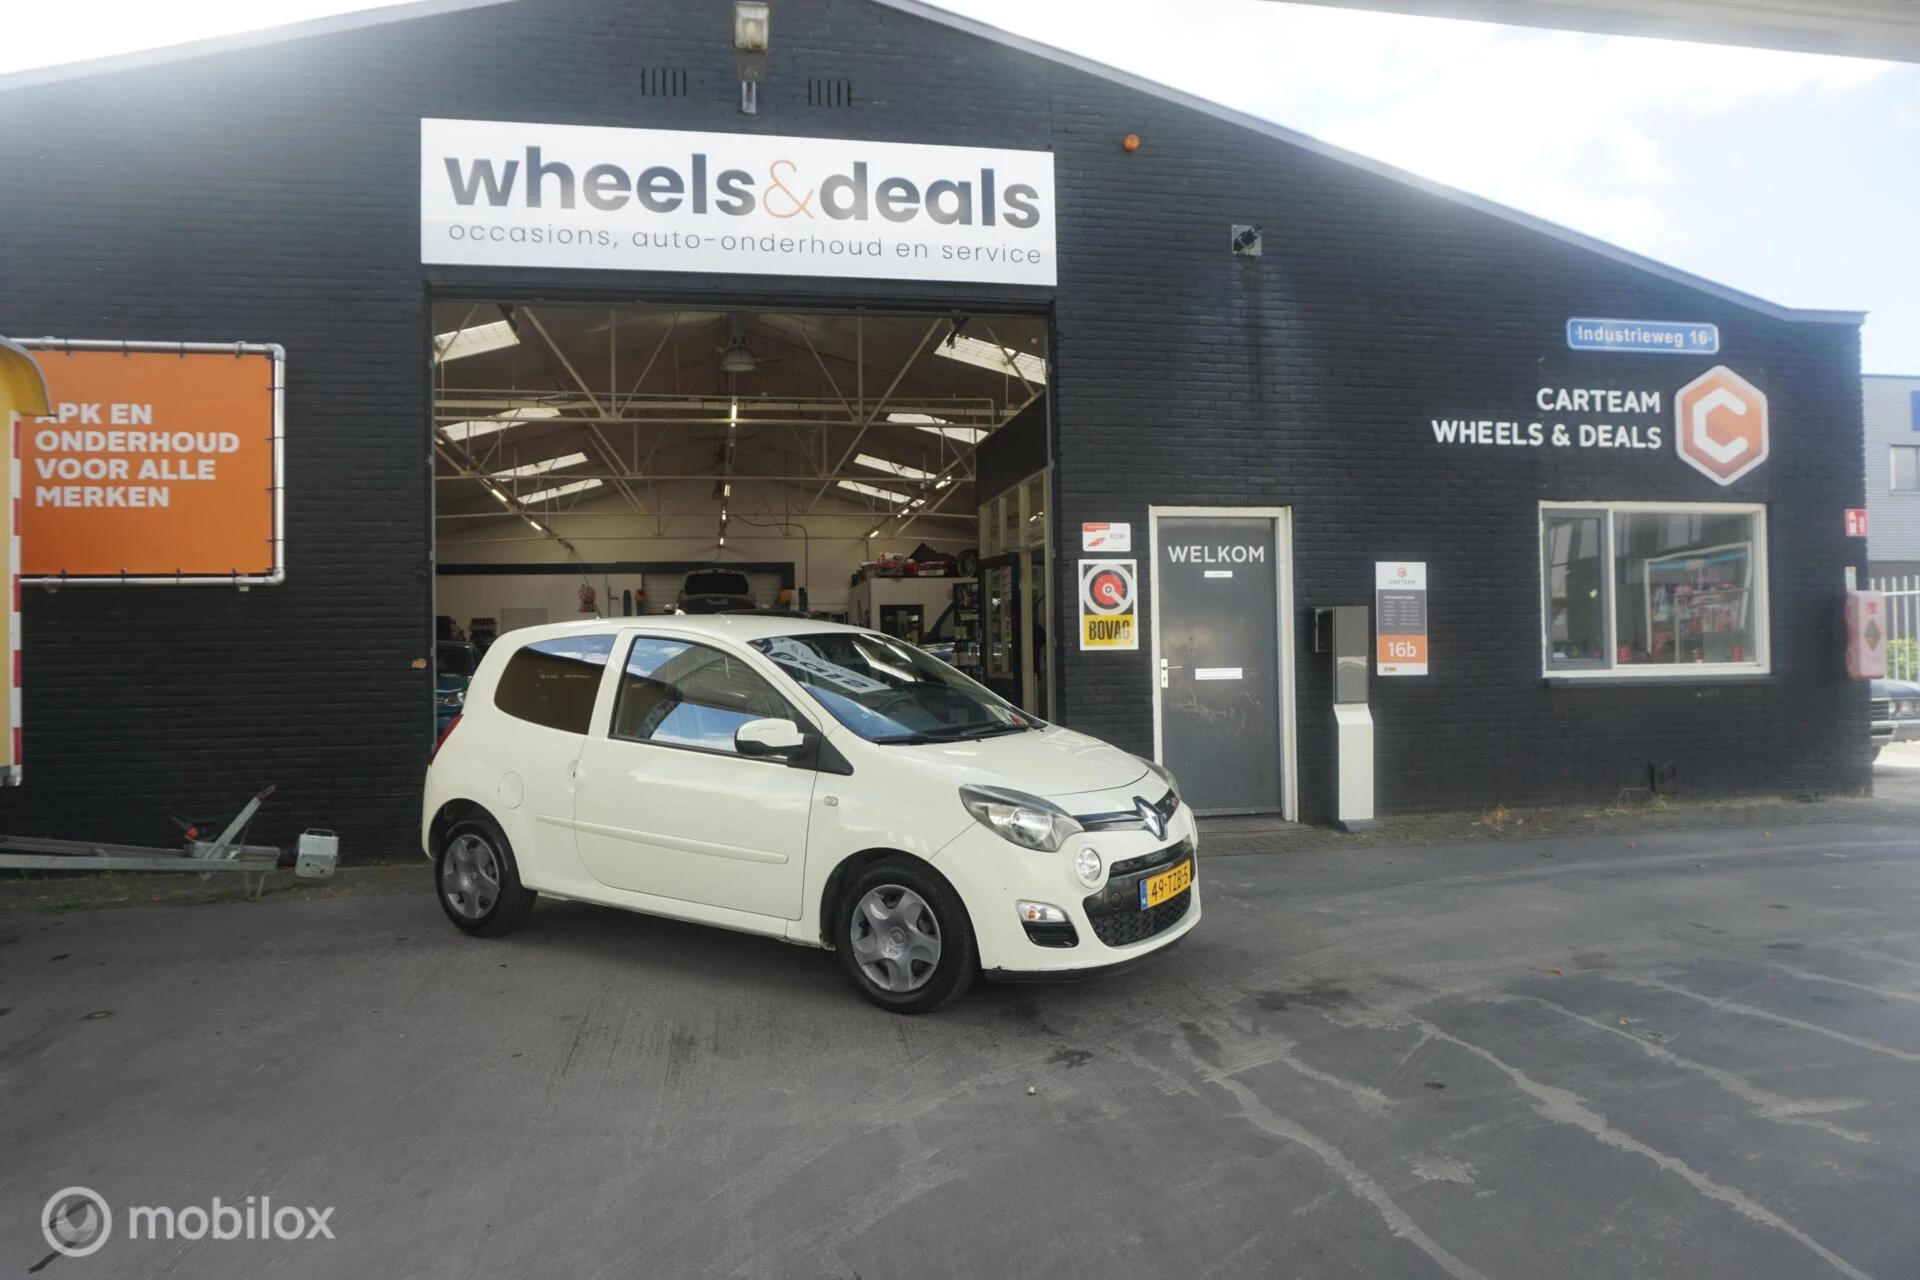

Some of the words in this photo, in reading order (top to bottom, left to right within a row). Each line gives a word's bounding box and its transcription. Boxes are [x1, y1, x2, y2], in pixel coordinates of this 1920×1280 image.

[448, 223, 619, 249] occasions,
[632, 231, 883, 257] auto-onderhoud
[895, 244, 929, 259] en
[941, 243, 1042, 264] service
[1577, 325, 1684, 348] Industrieweg
[1689, 330, 1709, 346] 16
[1536, 387, 1661, 413] CARTEAM
[110, 403, 153, 425] EN
[35, 431, 240, 453] ONDERHOUD
[1432, 420, 1544, 446] WHEELS
[1551, 424, 1571, 447] &
[1579, 424, 1662, 449] DEALS
[34, 458, 129, 480] VOOR
[137, 459, 217, 480] ALLE
[35, 486, 170, 507] MERKEN
[1167, 545, 1265, 563] WELKOM
[1089, 620, 1130, 641] BOVAG
[1388, 641, 1417, 658] 16b
